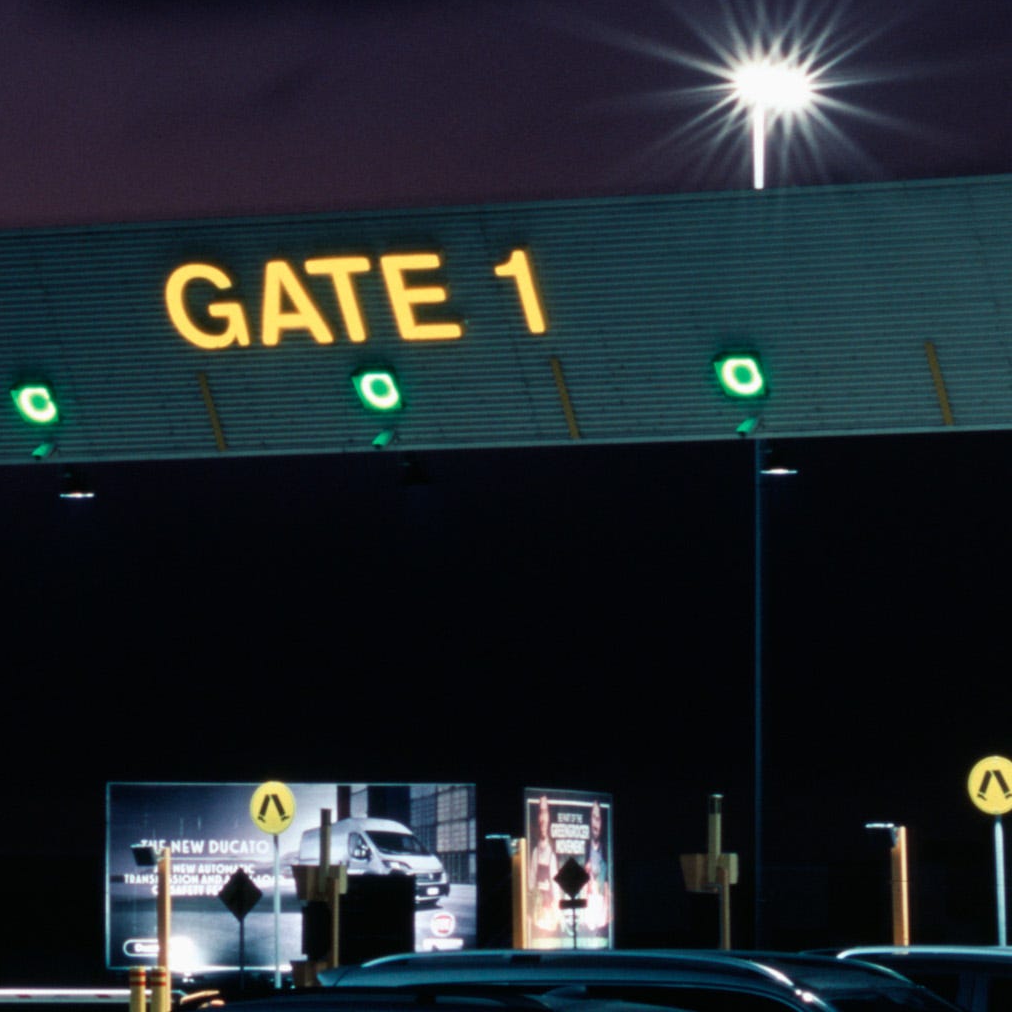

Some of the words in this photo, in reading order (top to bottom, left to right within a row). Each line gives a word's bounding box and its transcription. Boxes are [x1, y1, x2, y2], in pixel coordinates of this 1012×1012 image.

[163, 252, 462, 349] GATE
[495, 249, 547, 334] 1
[171, 839, 205, 854] NEW
[208, 839, 270, 854] DUCATO
[172, 863, 195, 874] NEW
